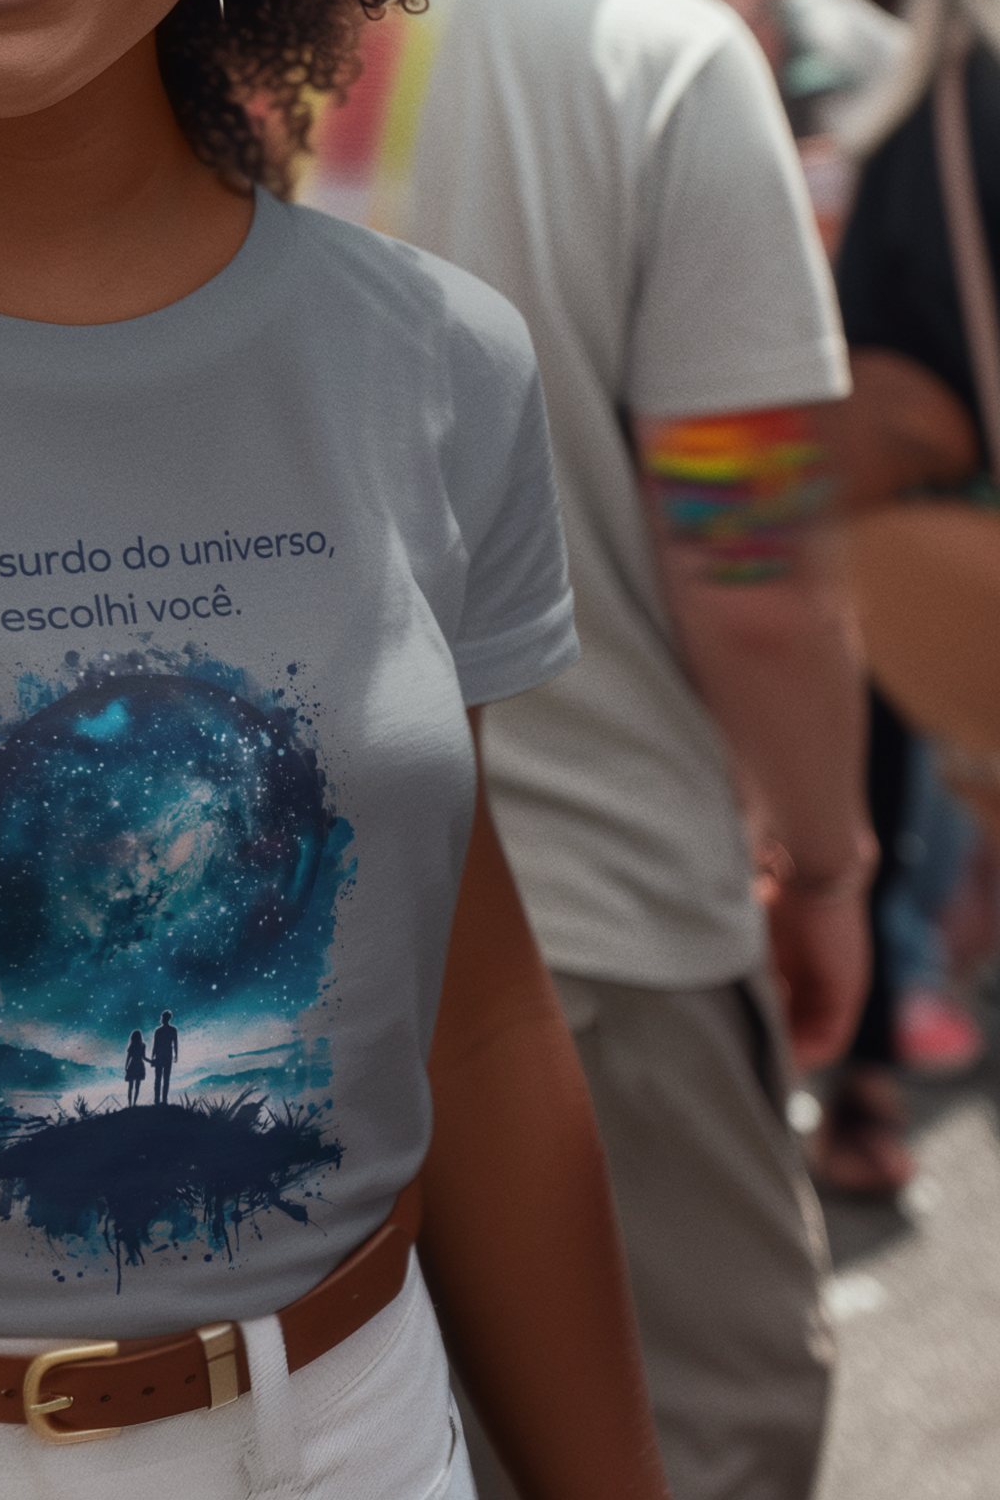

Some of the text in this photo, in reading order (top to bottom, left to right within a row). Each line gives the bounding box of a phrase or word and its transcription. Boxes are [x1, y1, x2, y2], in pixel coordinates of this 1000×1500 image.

[122, 535, 170, 571] do
[179, 529, 336, 566] universo,
[0, 584, 243, 632] escolhi você.
